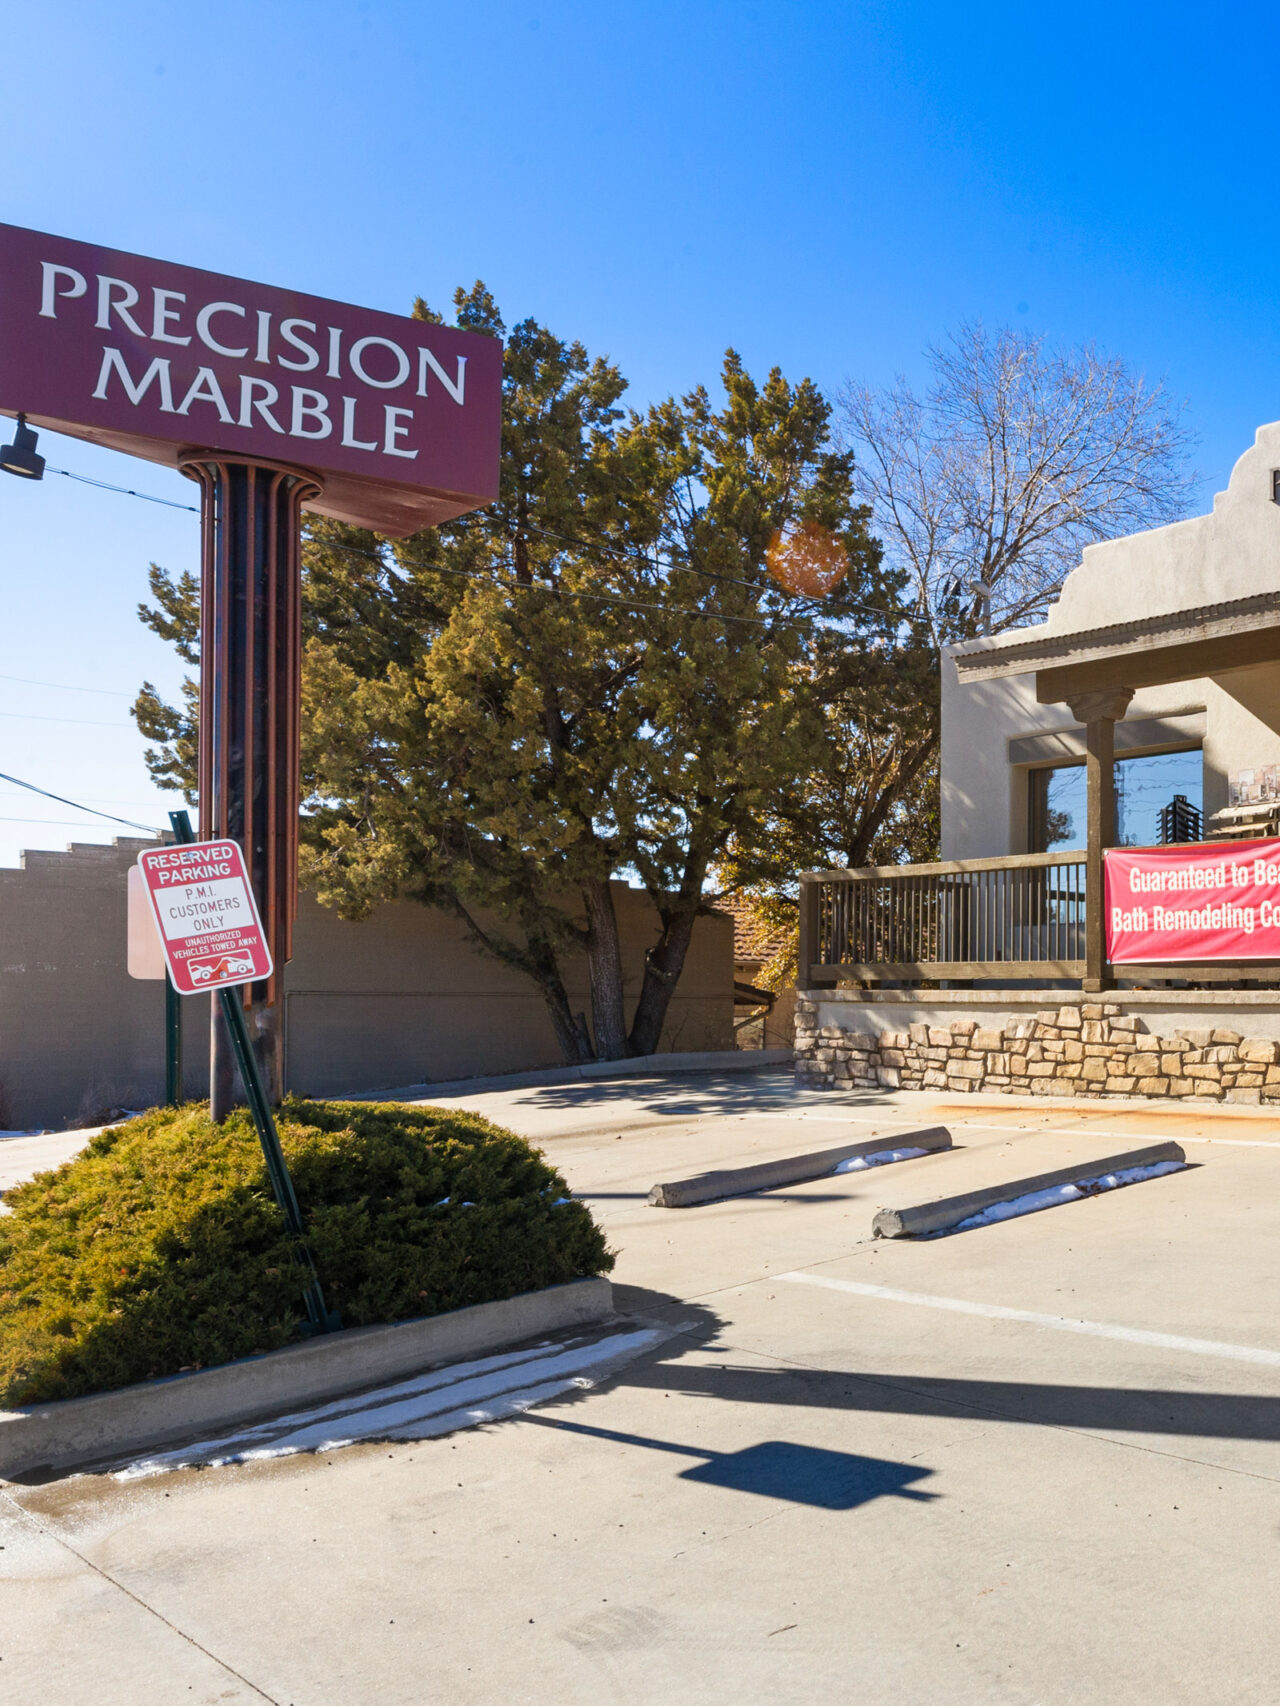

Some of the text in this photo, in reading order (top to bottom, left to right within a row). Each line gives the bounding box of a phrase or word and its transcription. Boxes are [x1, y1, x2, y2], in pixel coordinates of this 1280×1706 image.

[39, 261, 467, 405] PRECISION
[92, 346, 419, 459] MARBLE
[147, 846, 233, 870] RESERVED
[158, 863, 231, 885] PARKING
[1129, 862, 1226, 894] Guaranteed
[1230, 862, 1248, 887] to
[185, 885, 217, 900] P.M.I.
[169, 897, 240, 919] CUSTOMERS
[1112, 906, 1149, 934] Bath
[1153, 902, 1255, 934] Remodeling
[193, 916, 224, 931] ONLY
[172, 937, 257, 960] VEHICLES TOWED AWAY
[185, 931, 241, 948] UNAUTHORIZED
